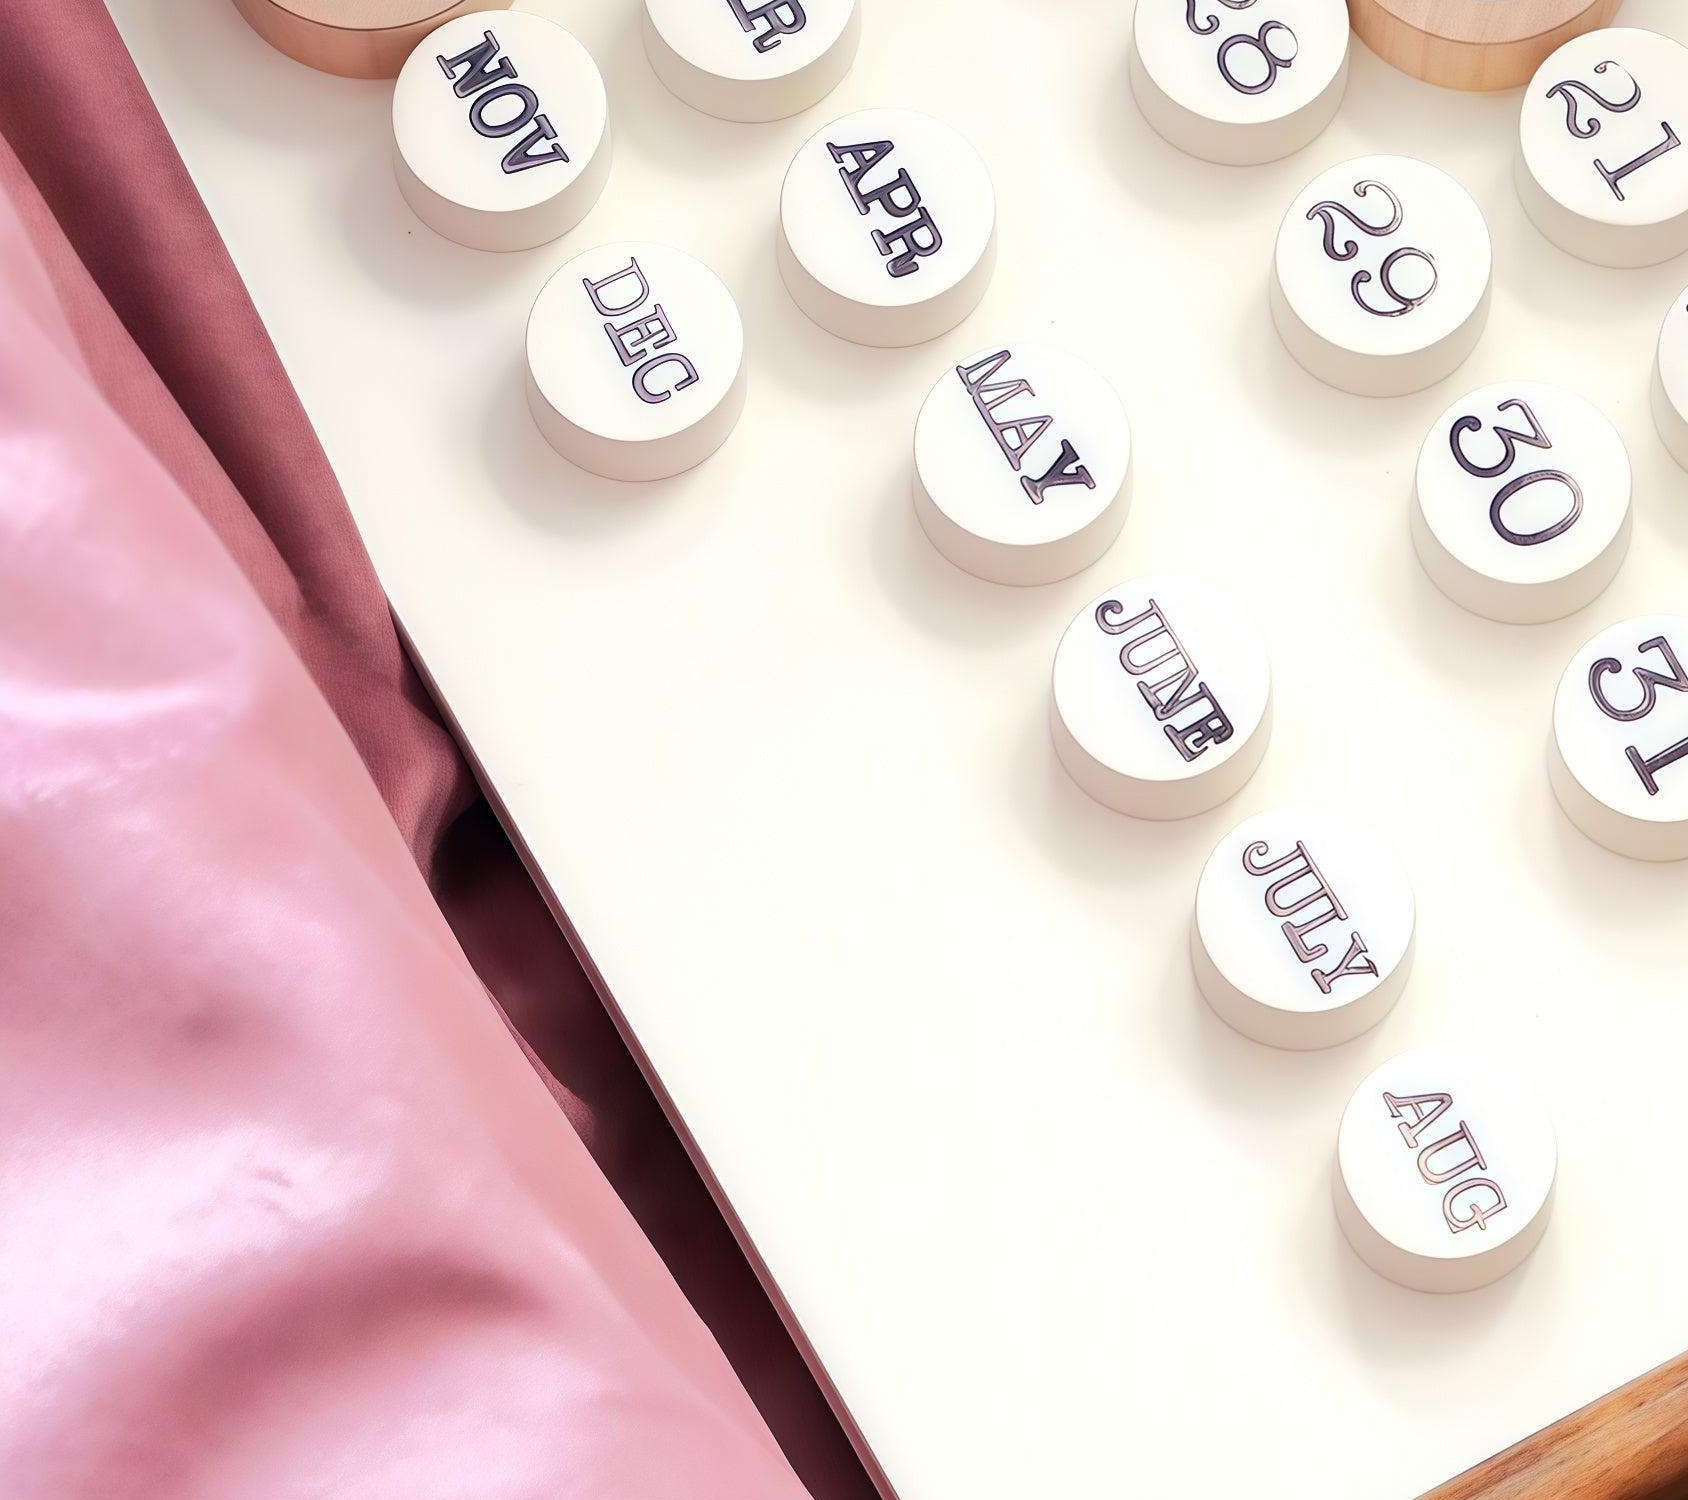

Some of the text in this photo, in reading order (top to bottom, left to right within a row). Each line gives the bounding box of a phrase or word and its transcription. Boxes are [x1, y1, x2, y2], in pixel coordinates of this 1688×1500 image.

[436, 29, 571, 175] NOV
[1545, 59, 1682, 202] 21
[826, 139, 944, 279] APR
[1305, 179, 1439, 318] 29
[581, 256, 700, 405] DEC
[955, 349, 1097, 506] MAY
[1448, 398, 1586, 548] 30
[1094, 598, 1235, 763] JUNE
[1240, 839, 1380, 996] JULY
[1382, 1091, 1510, 1236] AUG
